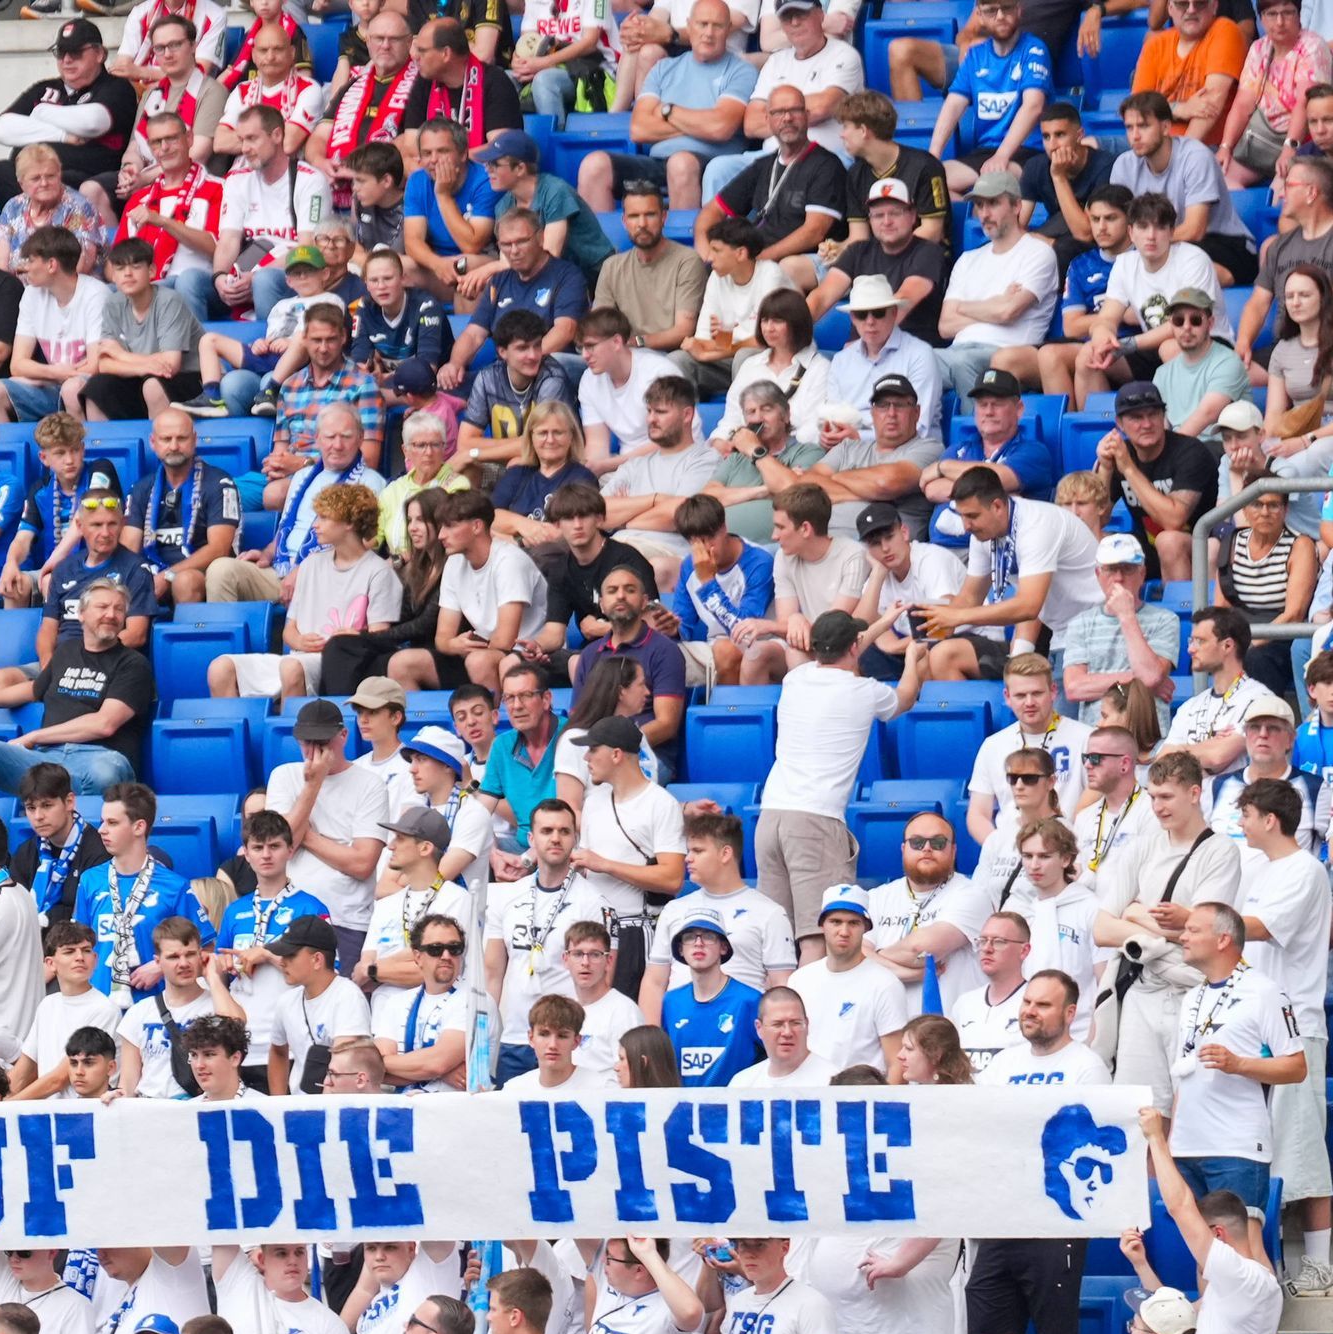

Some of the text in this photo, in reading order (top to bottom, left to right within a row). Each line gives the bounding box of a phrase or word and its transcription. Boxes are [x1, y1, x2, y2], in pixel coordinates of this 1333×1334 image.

[536, 16, 582, 36] REWE
[984, 97, 1013, 113] SAP
[681, 1052, 713, 1070] SAP
[197, 1107, 425, 1231] DIE
[519, 1100, 917, 1225] PISTE
